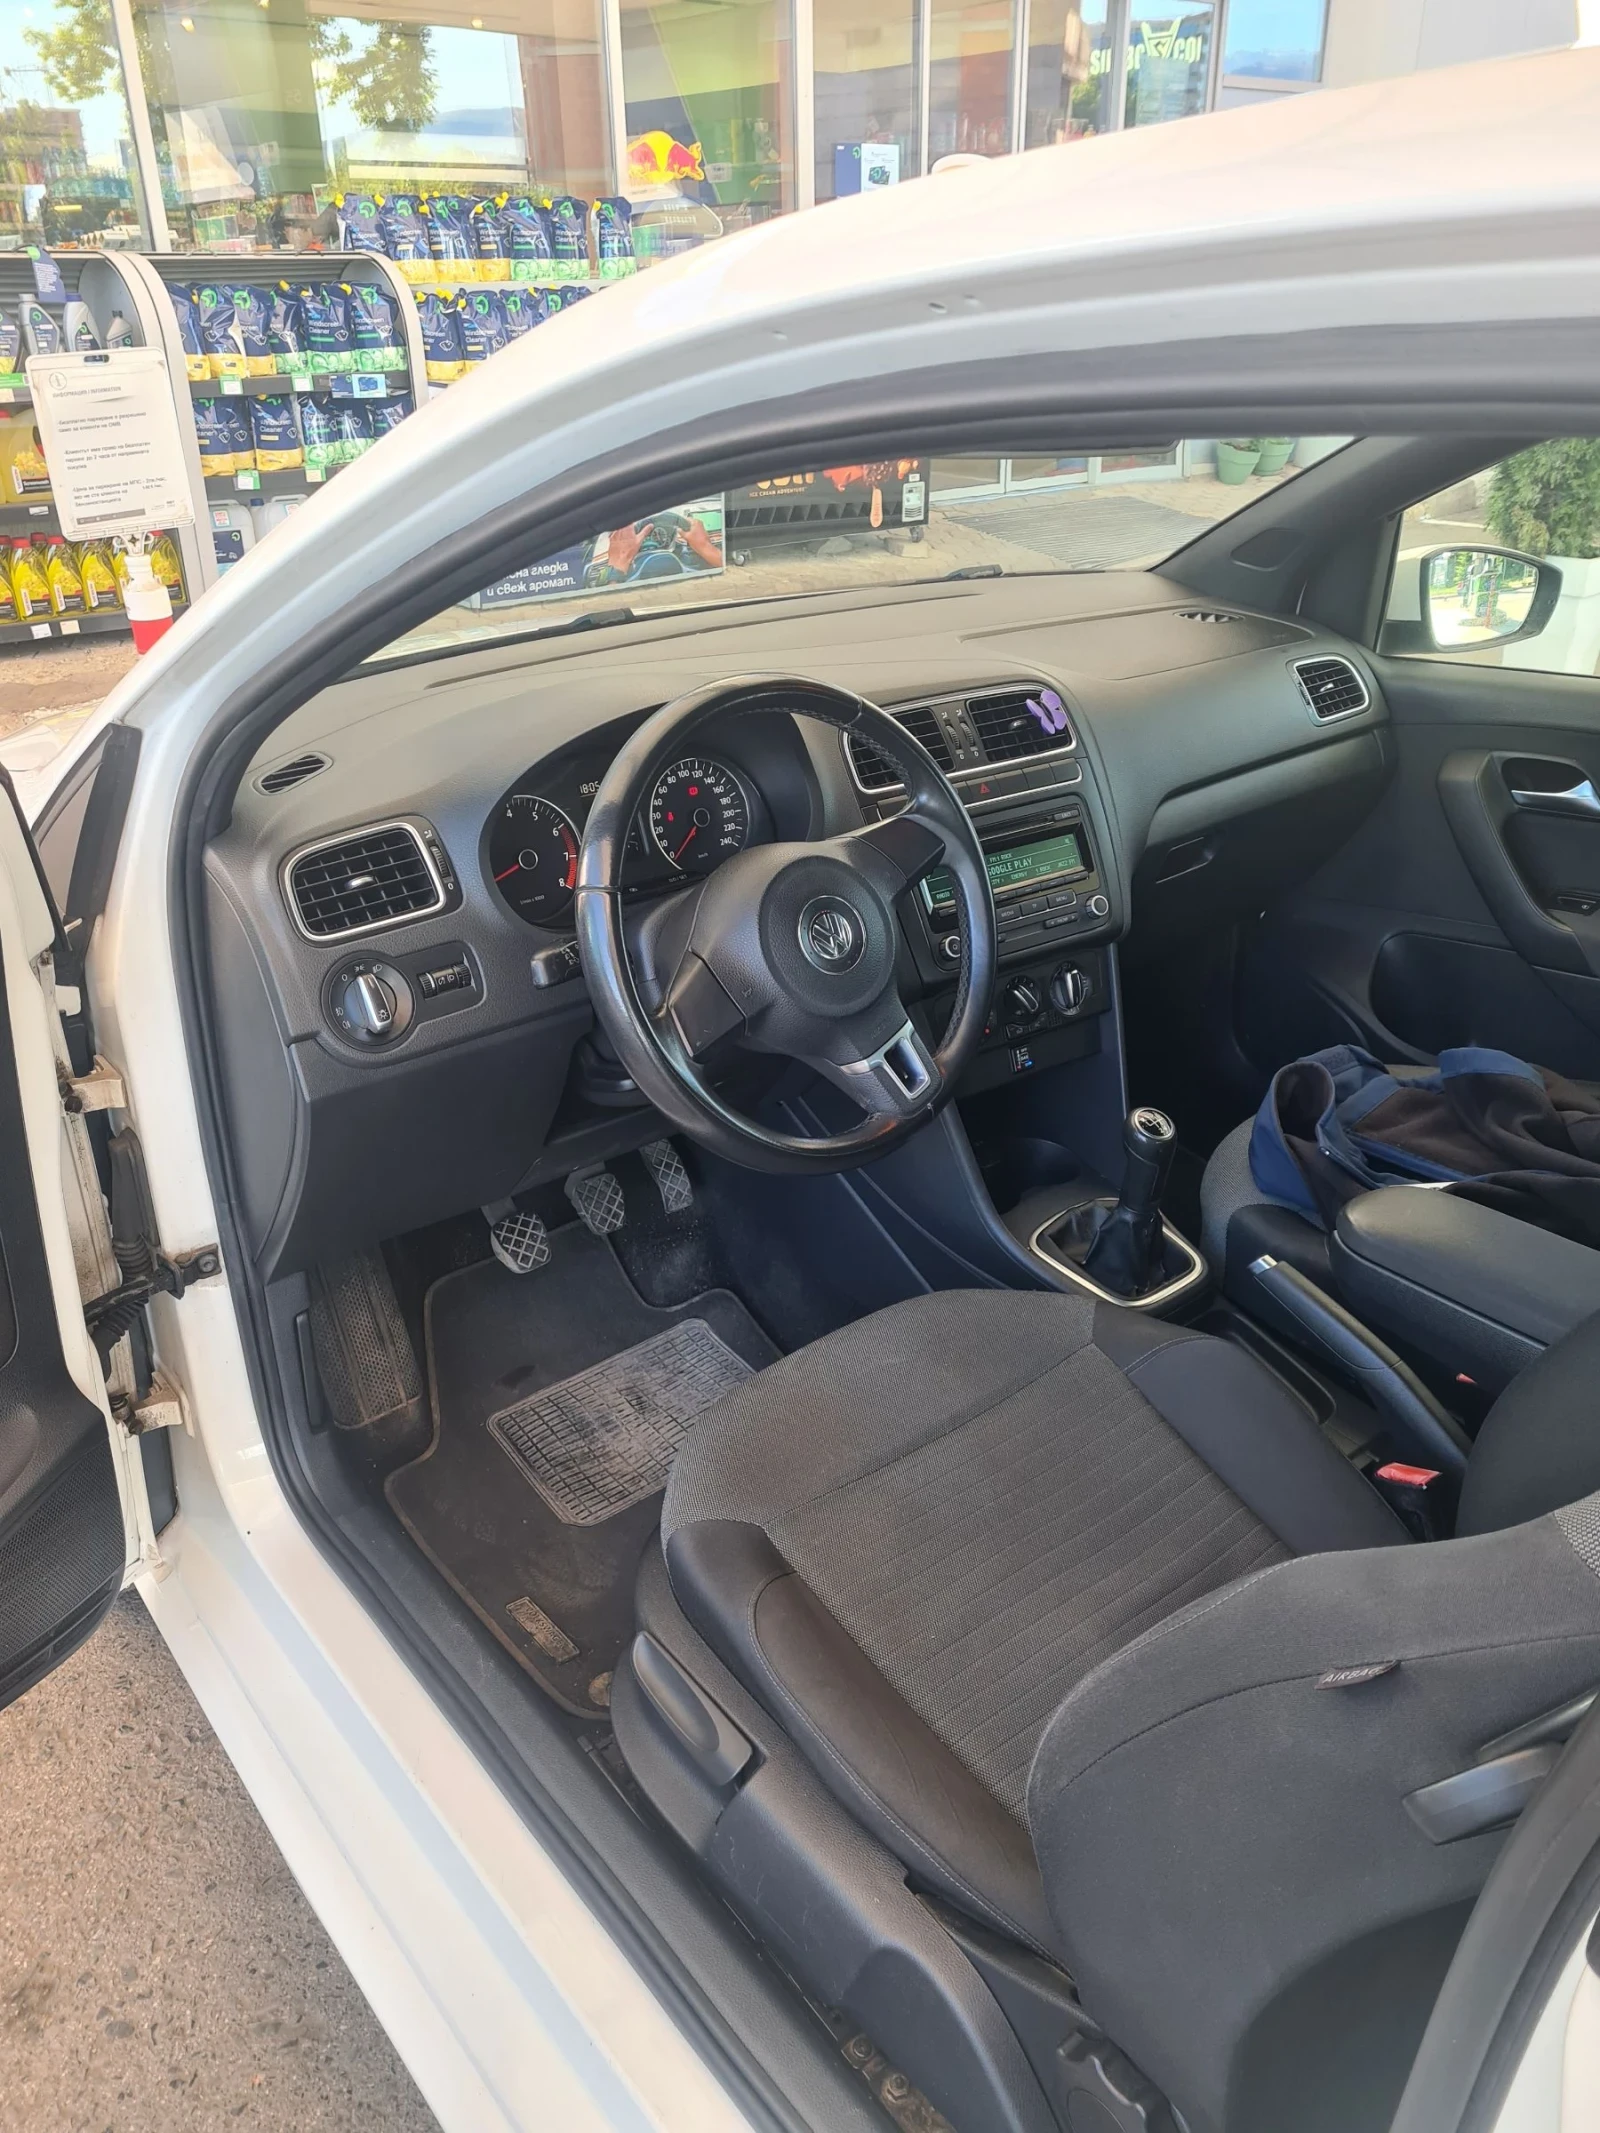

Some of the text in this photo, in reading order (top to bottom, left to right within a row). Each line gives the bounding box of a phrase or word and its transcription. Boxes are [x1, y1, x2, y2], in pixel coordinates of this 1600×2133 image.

[531, 561, 569, 576] гледка
[496, 581, 528, 595] свеж
[677, 769, 690, 779] 100
[691, 770, 703, 778] 120
[667, 775, 677, 784] 80
[703, 776, 716, 785] 140
[658, 785, 668, 794] 60
[712, 785, 725, 794] 160
[653, 798, 663, 807] 40
[719, 796, 732, 805] 180
[506, 809, 513, 819] 4
[532, 811, 539, 821] 5
[722, 809, 735, 818] 200
[552, 827, 559, 837] 6
[654, 826, 664, 835] 20
[723, 823, 736, 832] 220
[660, 840, 668, 848] 10
[720, 837, 733, 847] 240
[1014, 857, 1032, 870] PLAY
[559, 878, 566, 889] 8
[1322, 1667, 1384, 1684] AIRBAG
